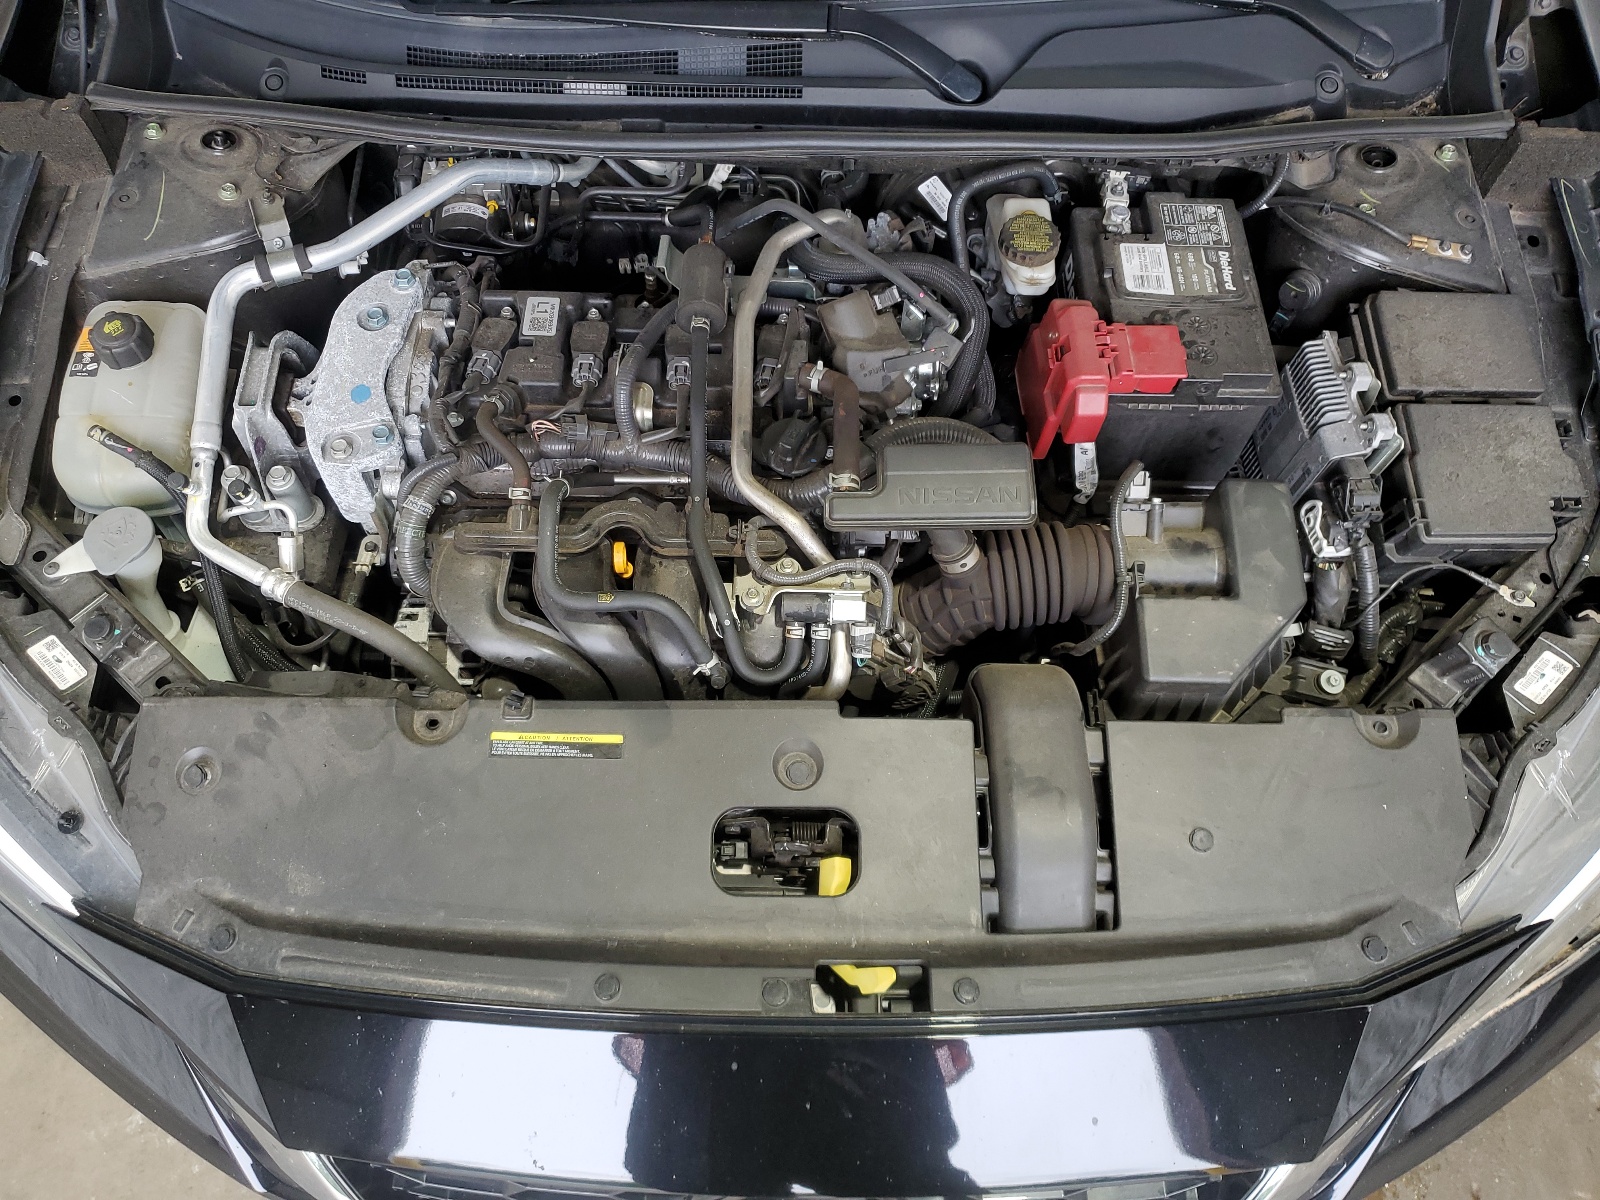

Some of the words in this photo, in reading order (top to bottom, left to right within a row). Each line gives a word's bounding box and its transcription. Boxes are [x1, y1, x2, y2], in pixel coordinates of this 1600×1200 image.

[1203, 269, 1213, 293] PLATINUM
[1218, 250, 1237, 291] DieHard
[536, 301, 550, 314] L1
[899, 485, 1021, 505] NISSAN
